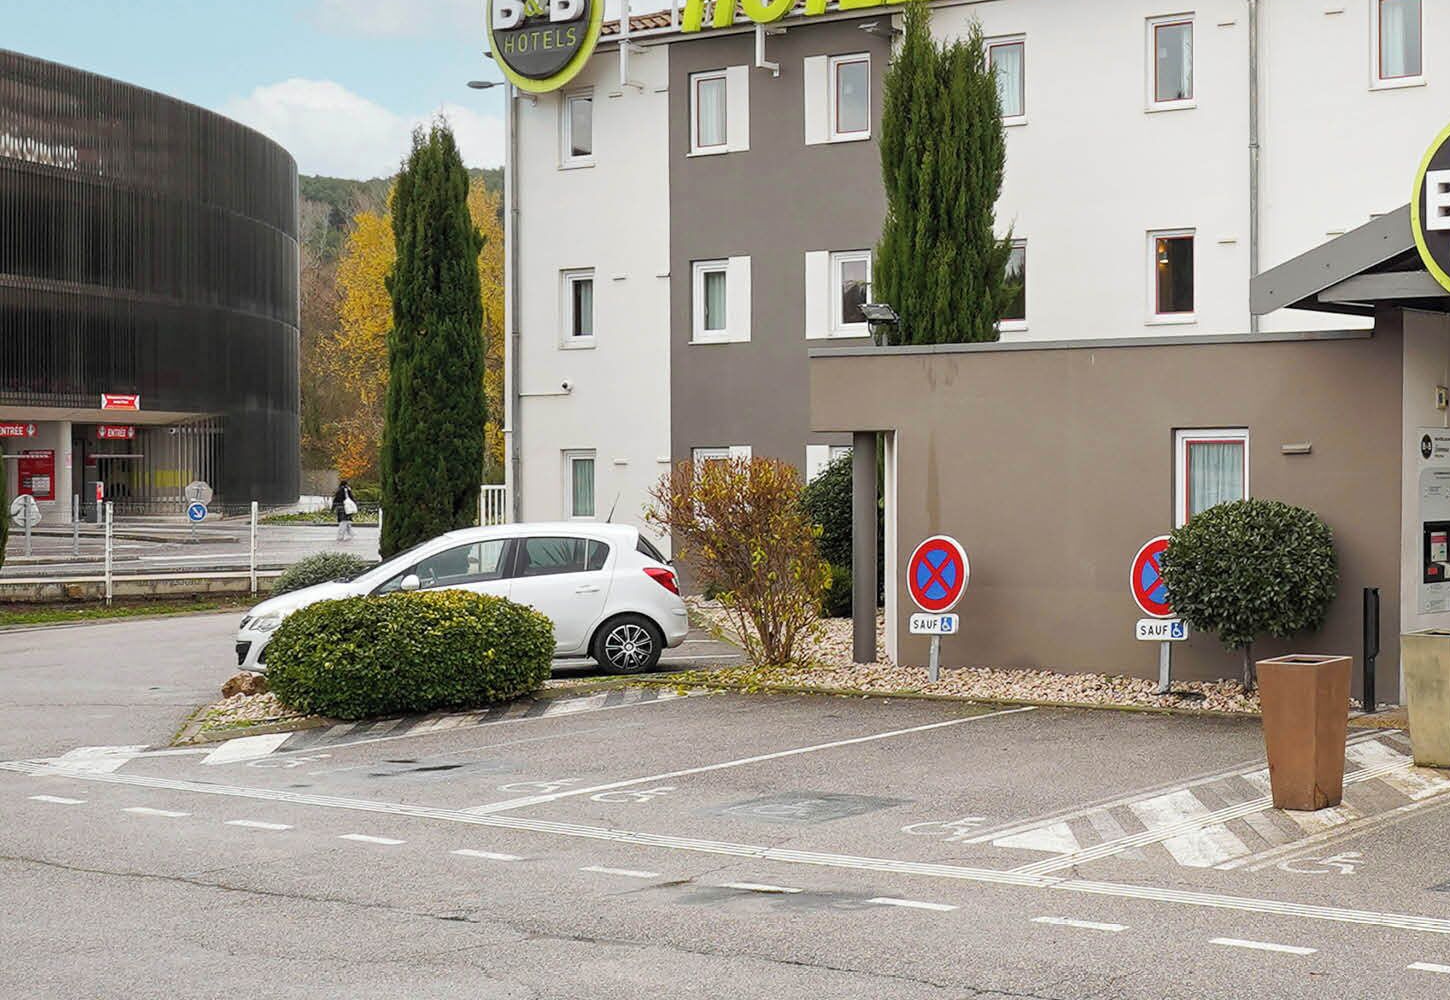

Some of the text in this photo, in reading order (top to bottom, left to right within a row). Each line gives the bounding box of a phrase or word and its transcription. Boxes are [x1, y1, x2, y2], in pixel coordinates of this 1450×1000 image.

[503, 27, 578, 55] HOTELS
[913, 619, 938, 630] SAUF
[1140, 625, 1168, 636] SAUF
